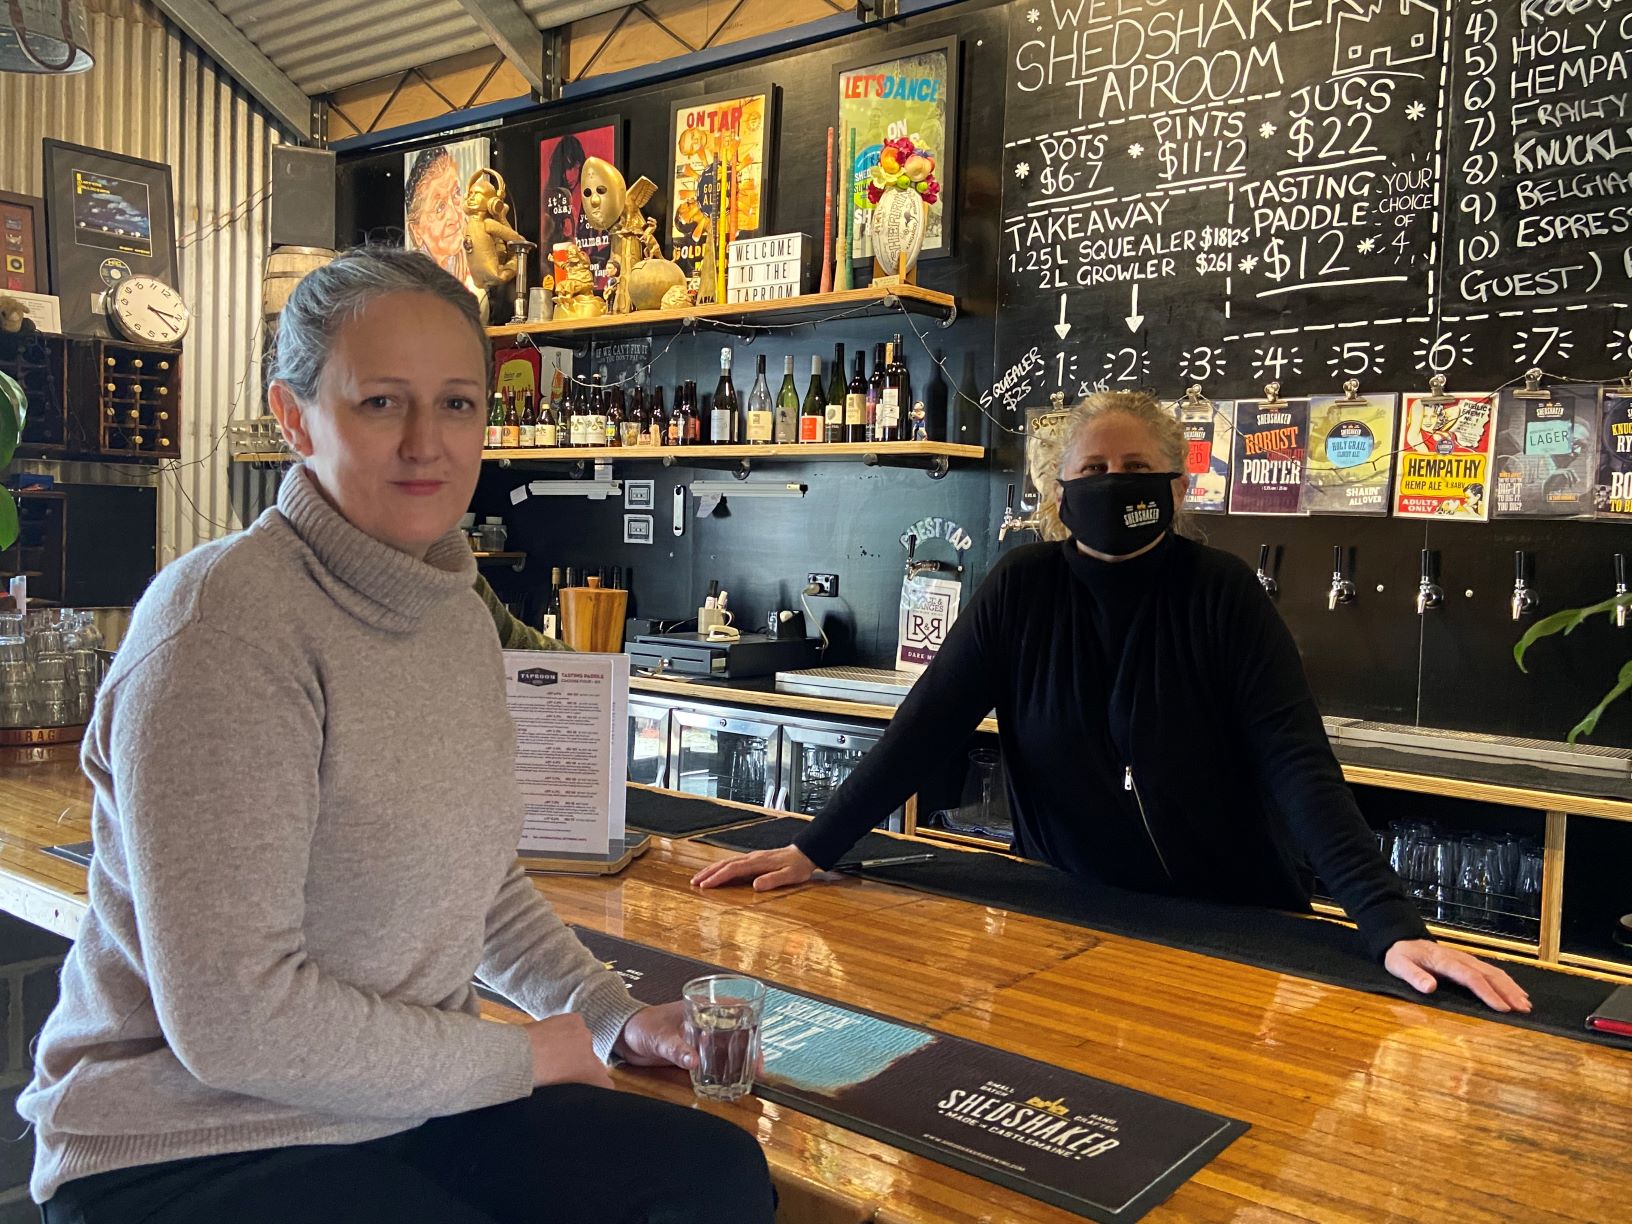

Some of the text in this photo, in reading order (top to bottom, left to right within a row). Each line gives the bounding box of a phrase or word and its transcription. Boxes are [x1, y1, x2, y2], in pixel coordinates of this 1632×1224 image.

[1465, 42, 1497, 76] 5)
[1512, 20, 1606, 64] HOLY
[844, 74, 940, 102] LET'S DANCE
[1065, 42, 1284, 119] TAPROOM
[1464, 50, 1632, 110] 6) HEMPA
[1289, 77, 1395, 118] JUGS
[686, 107, 743, 133] ON TAP
[887, 119, 907, 139] ON
[1152, 111, 1246, 143] PINTS
[1464, 93, 1627, 152] 7) FRAILTY
[1040, 135, 1108, 165] POTS
[1287, 112, 1378, 162] $22
[1158, 139, 1246, 180] $11-12
[1462, 126, 1632, 184] 8) KNUCKL
[1041, 161, 1102, 194] $6-7
[1239, 168, 1432, 208] TASTING YOUR
[553, 203, 574, 215] okay
[1460, 172, 1632, 224] 9) BELGIA
[1005, 199, 1170, 251] TAKEAWAY
[1254, 194, 1433, 237] PADDLE CHOICE
[1395, 213, 1416, 227] OF
[575, 234, 610, 249] human
[736, 239, 792, 261] WELCOME
[1079, 230, 1196, 262] SQUEALER
[1392, 231, 1410, 254] 4
[1459, 206, 1632, 265] 10) ESPRES
[741, 262, 787, 283] TO THE
[1077, 258, 1176, 285] GROWLER
[1264, 230, 1350, 282] $12
[737, 284, 793, 304] TAPROOM
[1343, 341, 1370, 375] 5
[1429, 332, 1456, 371] 6
[1531, 327, 1559, 364] 7
[980, 347, 1041, 408] SQUEALER
[1056, 351, 1065, 387] 1
[1118, 348, 1138, 381] 2
[1190, 346, 1212, 380] 3
[1264, 346, 1288, 379] 4
[1244, 426, 1299, 455] ROBUST
[1530, 430, 1568, 447] LAGER
[1241, 459, 1301, 485] PORTER
[1407, 458, 1481, 478] HEMPATHY
[1402, 498, 1439, 506] ADULTS
[1405, 481, 1427, 490] HEMP
[1428, 481, 1442, 490] ALE
[1124, 508, 1160, 526] SHEDSHAKER
[944, 521, 972, 551] TAP
[908, 652, 925, 660] DARK
[985, 1080, 1015, 1094] SMALL
[937, 1089, 1121, 1158] SHEDSHAKER
[945, 1111, 979, 1126] MADE
[987, 1126, 1075, 1158] CASTLEMAINE
